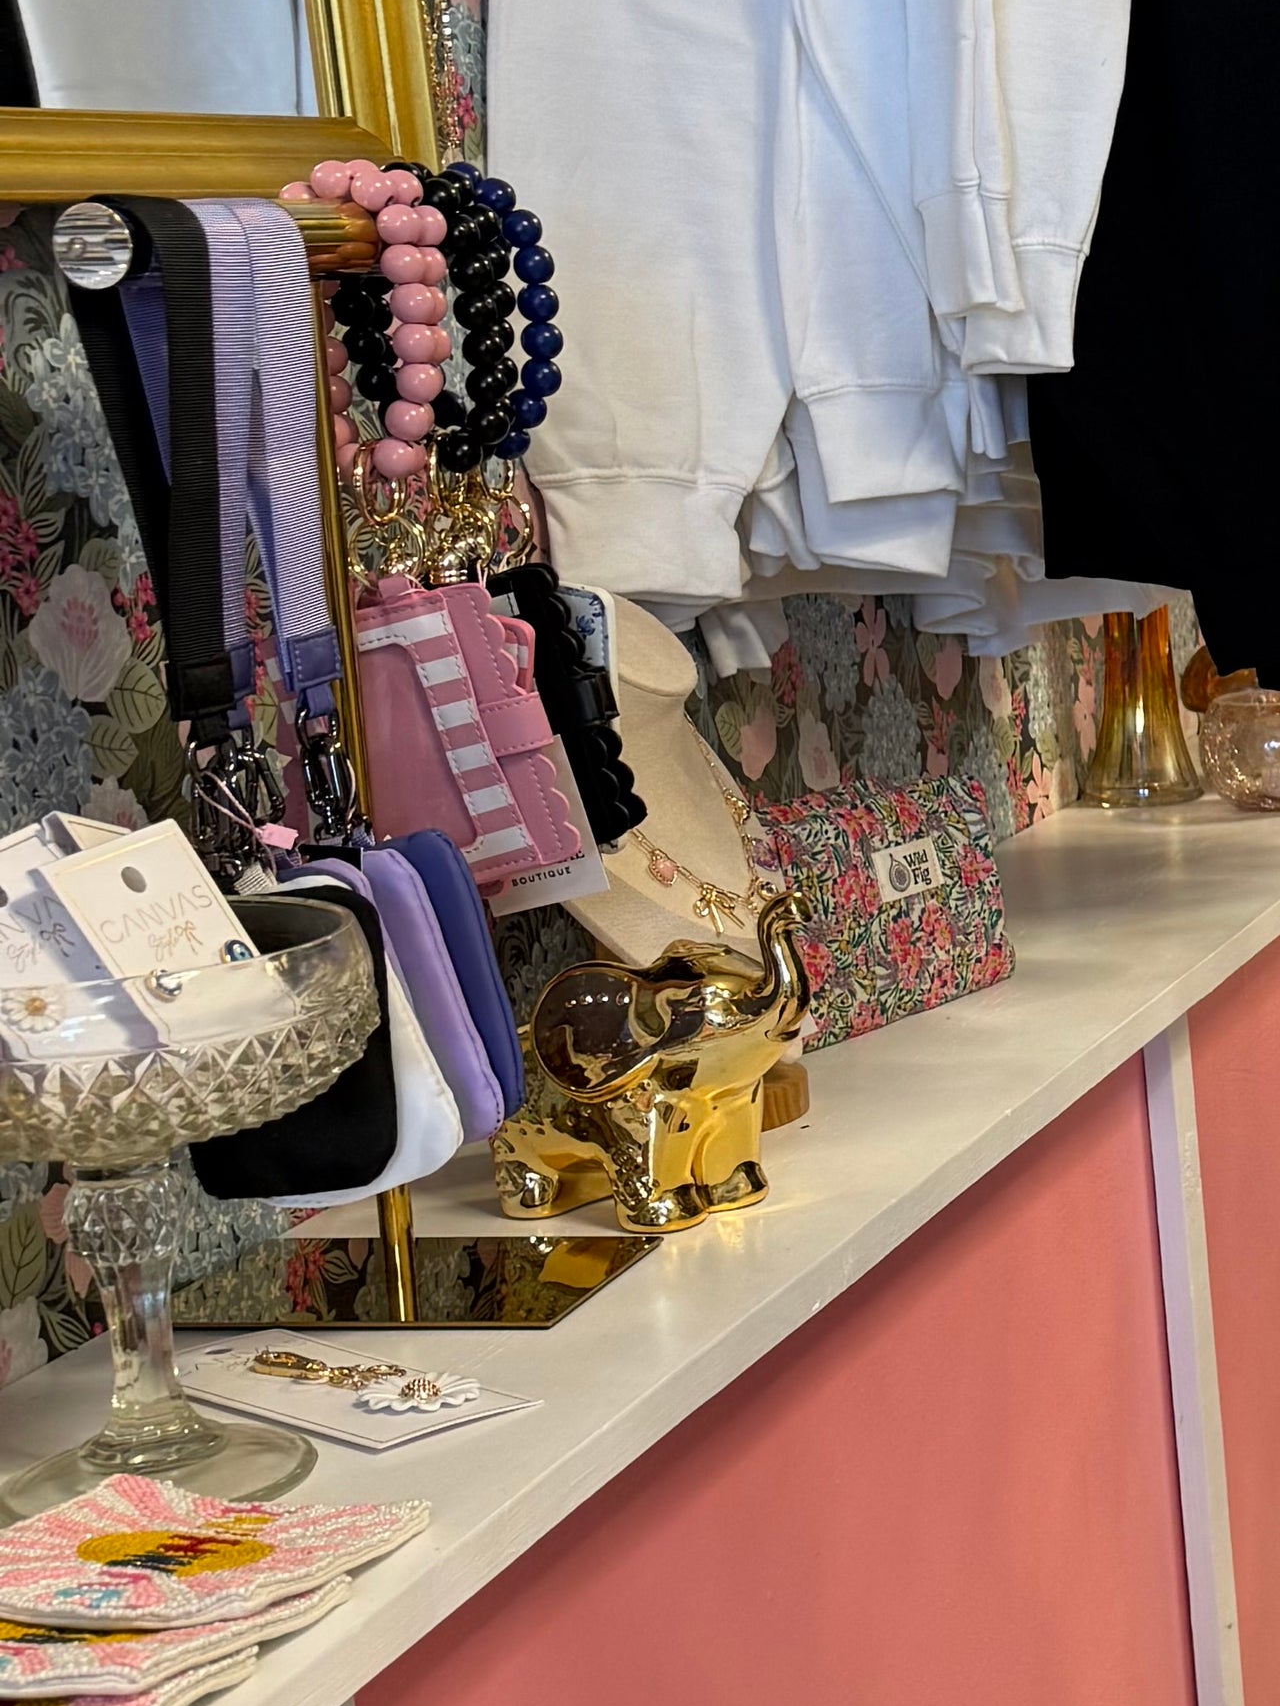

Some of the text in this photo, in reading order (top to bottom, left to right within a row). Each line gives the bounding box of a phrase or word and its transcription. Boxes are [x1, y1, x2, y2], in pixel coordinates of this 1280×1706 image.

[902, 849, 928, 869] Wild
[511, 865, 572, 887] BOUTIQUE
[911, 866, 932, 886] Fig
[99, 884, 213, 944] CANVAS
